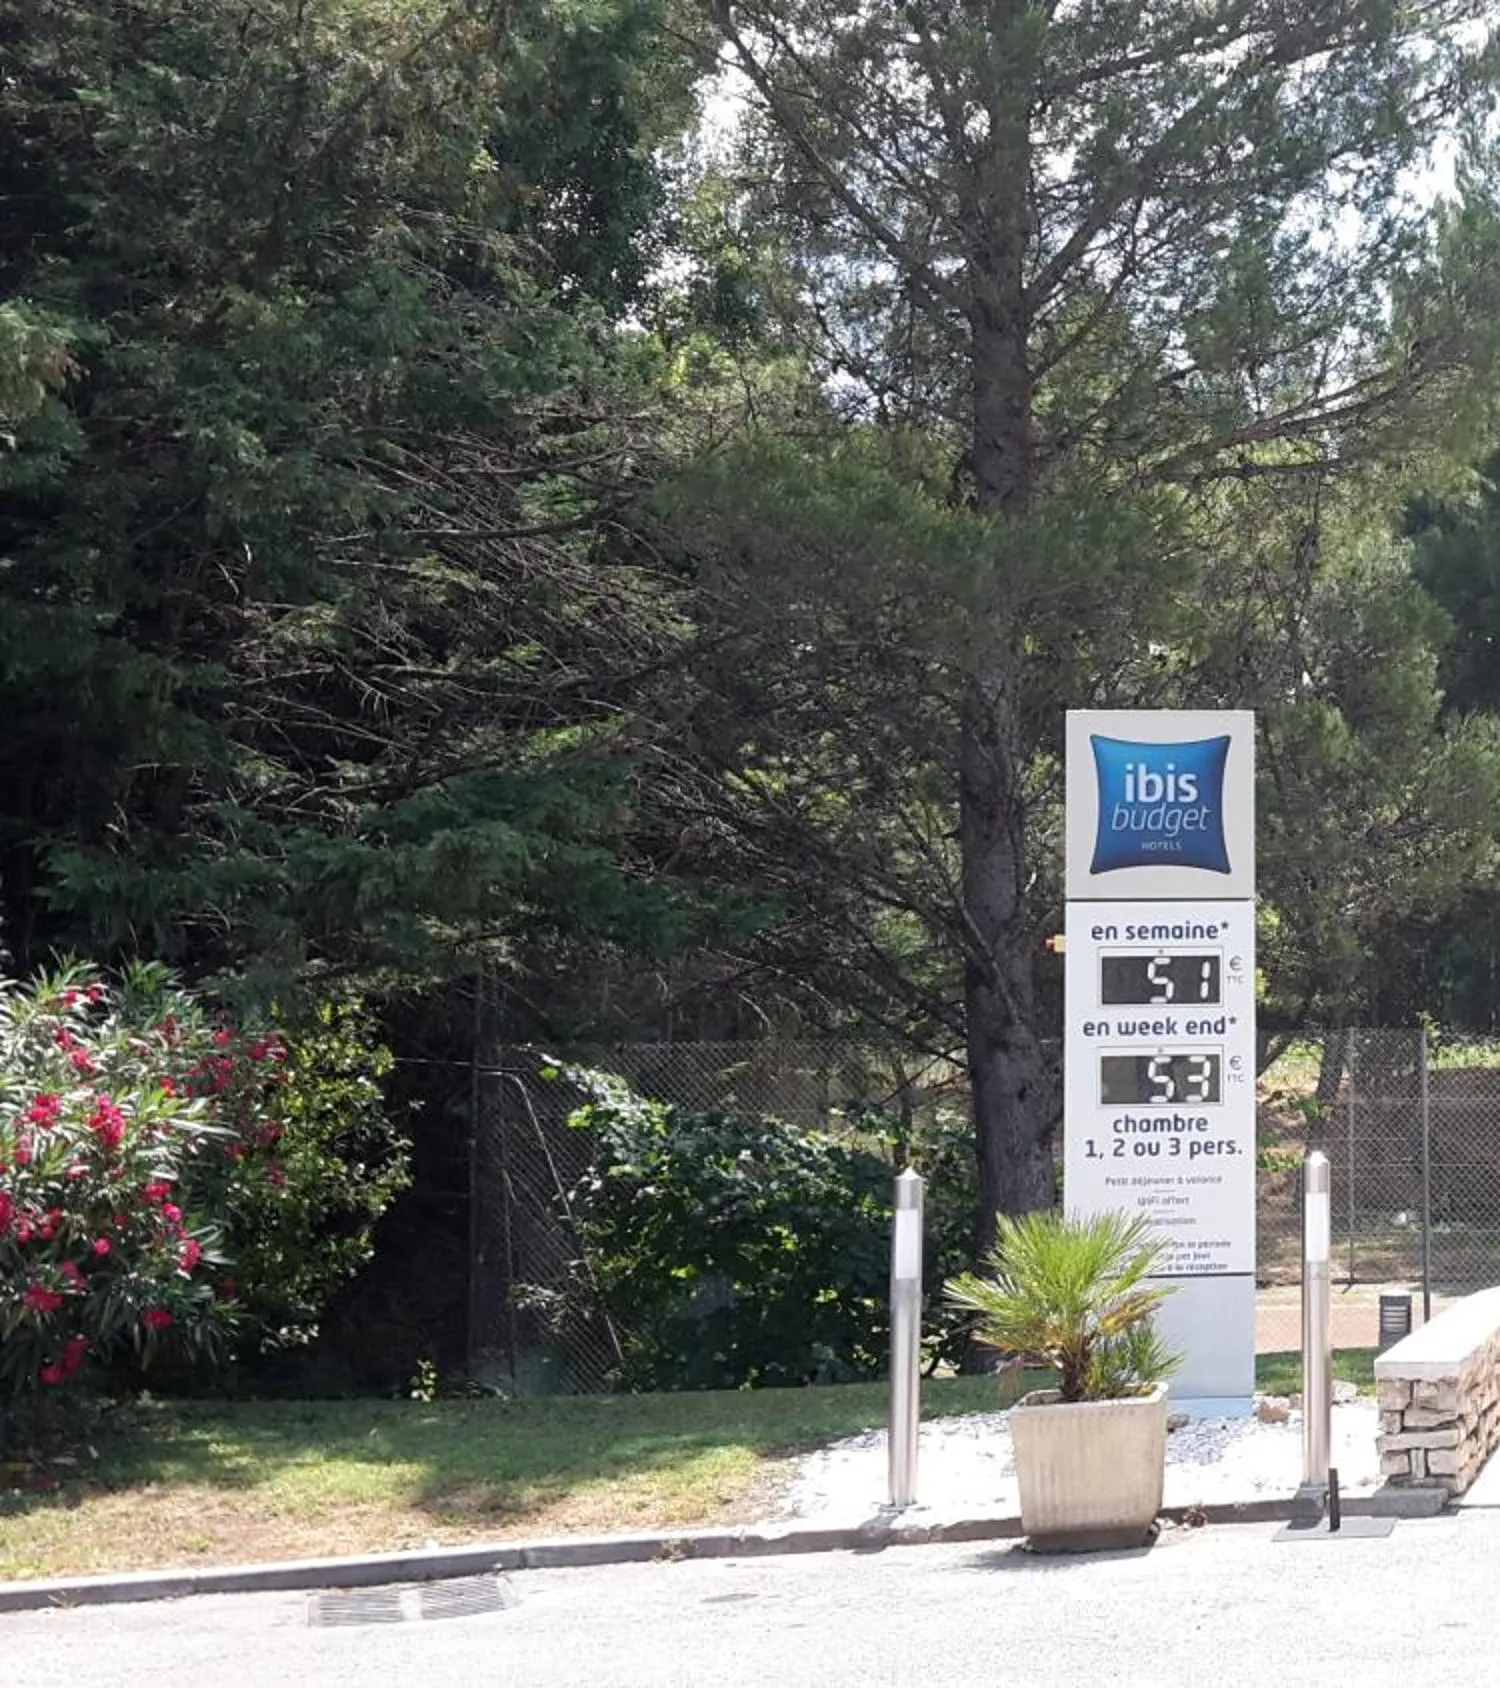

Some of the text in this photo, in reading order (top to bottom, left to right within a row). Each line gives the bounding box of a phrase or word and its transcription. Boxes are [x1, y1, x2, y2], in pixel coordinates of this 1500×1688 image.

[1125, 763, 1199, 803] ibis
[1112, 803, 1212, 837] budget
[1141, 841, 1182, 850] HOTELS
[1091, 925, 1118, 940] en
[1147, 957, 1211, 1004] 51
[1083, 1021, 1110, 1036] en
[1117, 1017, 1177, 1036] week
[1147, 1056, 1211, 1103] 53
[1113, 1114, 1209, 1133] chambre
[1085, 1138, 1243, 1160] 1, 2 ou 3 pers.
[1161, 1196, 1190, 1205] offert
